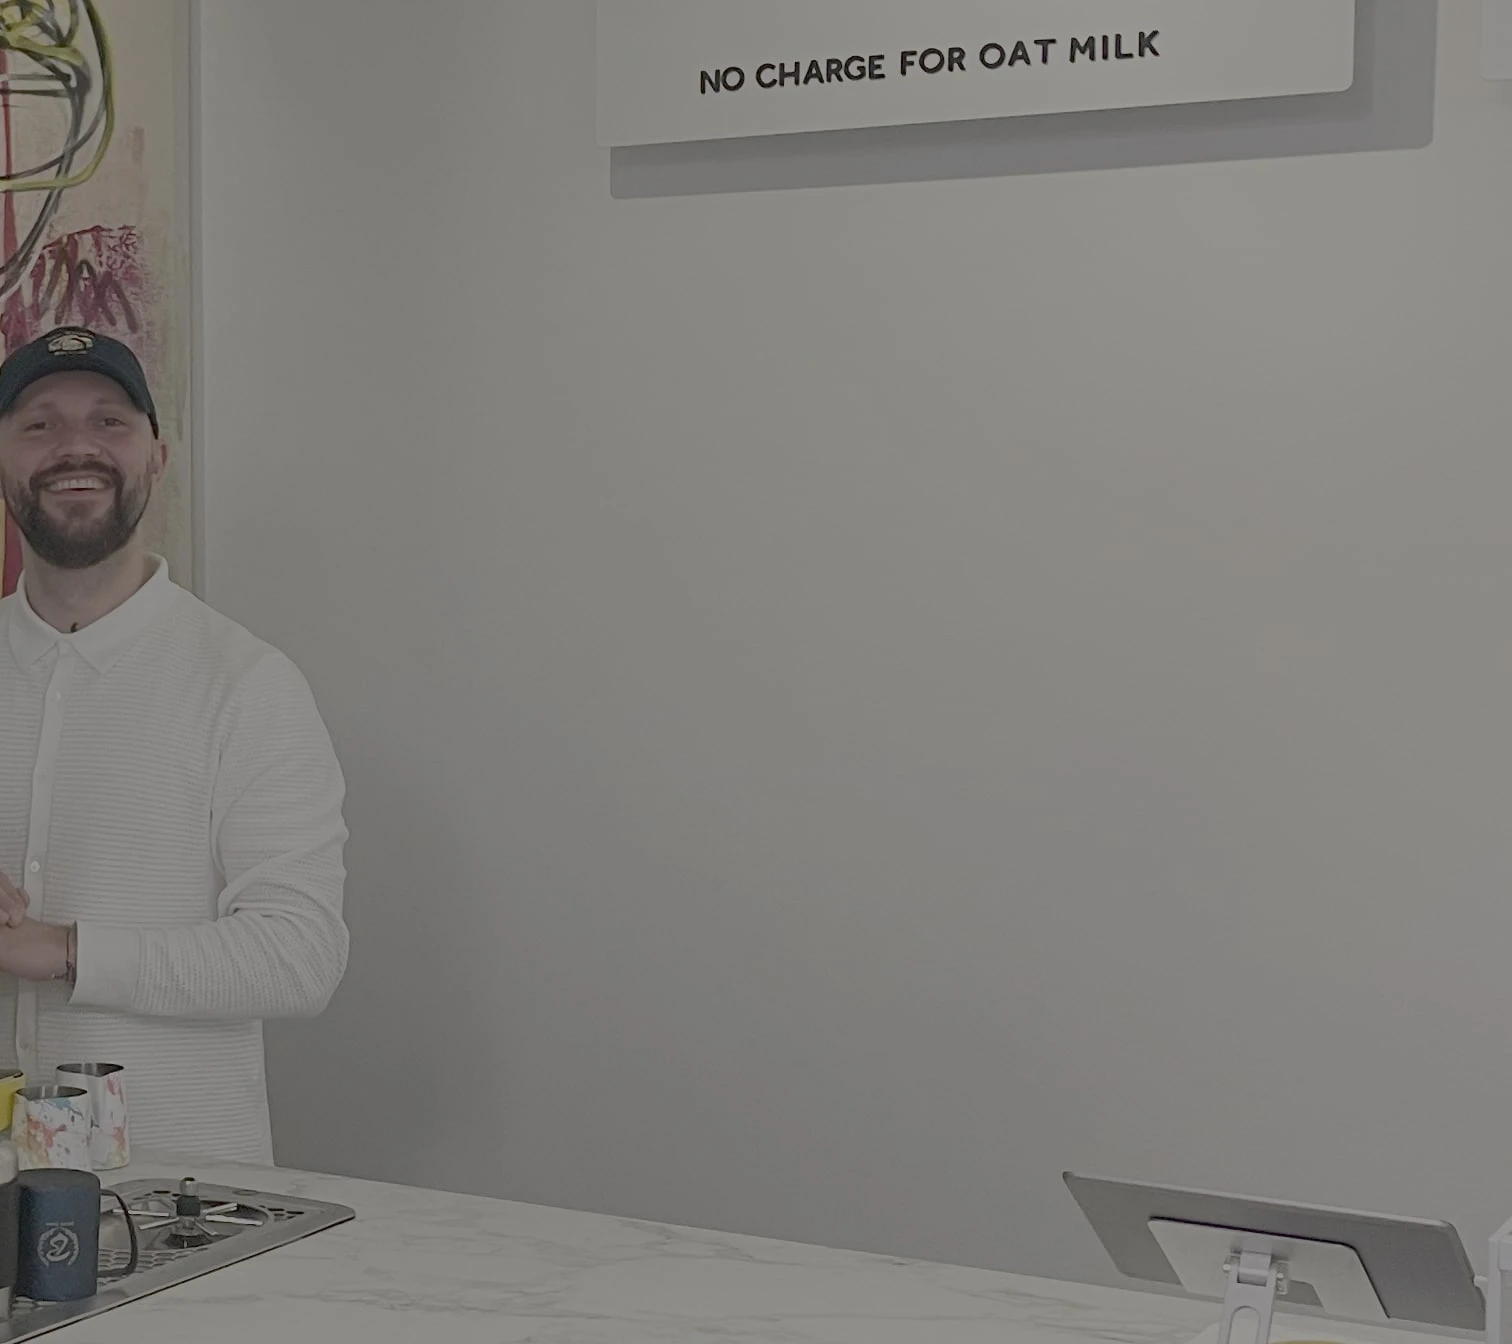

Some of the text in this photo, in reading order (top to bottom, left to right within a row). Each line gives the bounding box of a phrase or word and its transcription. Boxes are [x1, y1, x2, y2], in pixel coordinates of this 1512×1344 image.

[700, 30, 1160, 95] NO CHARGE FOR OAT MILK
